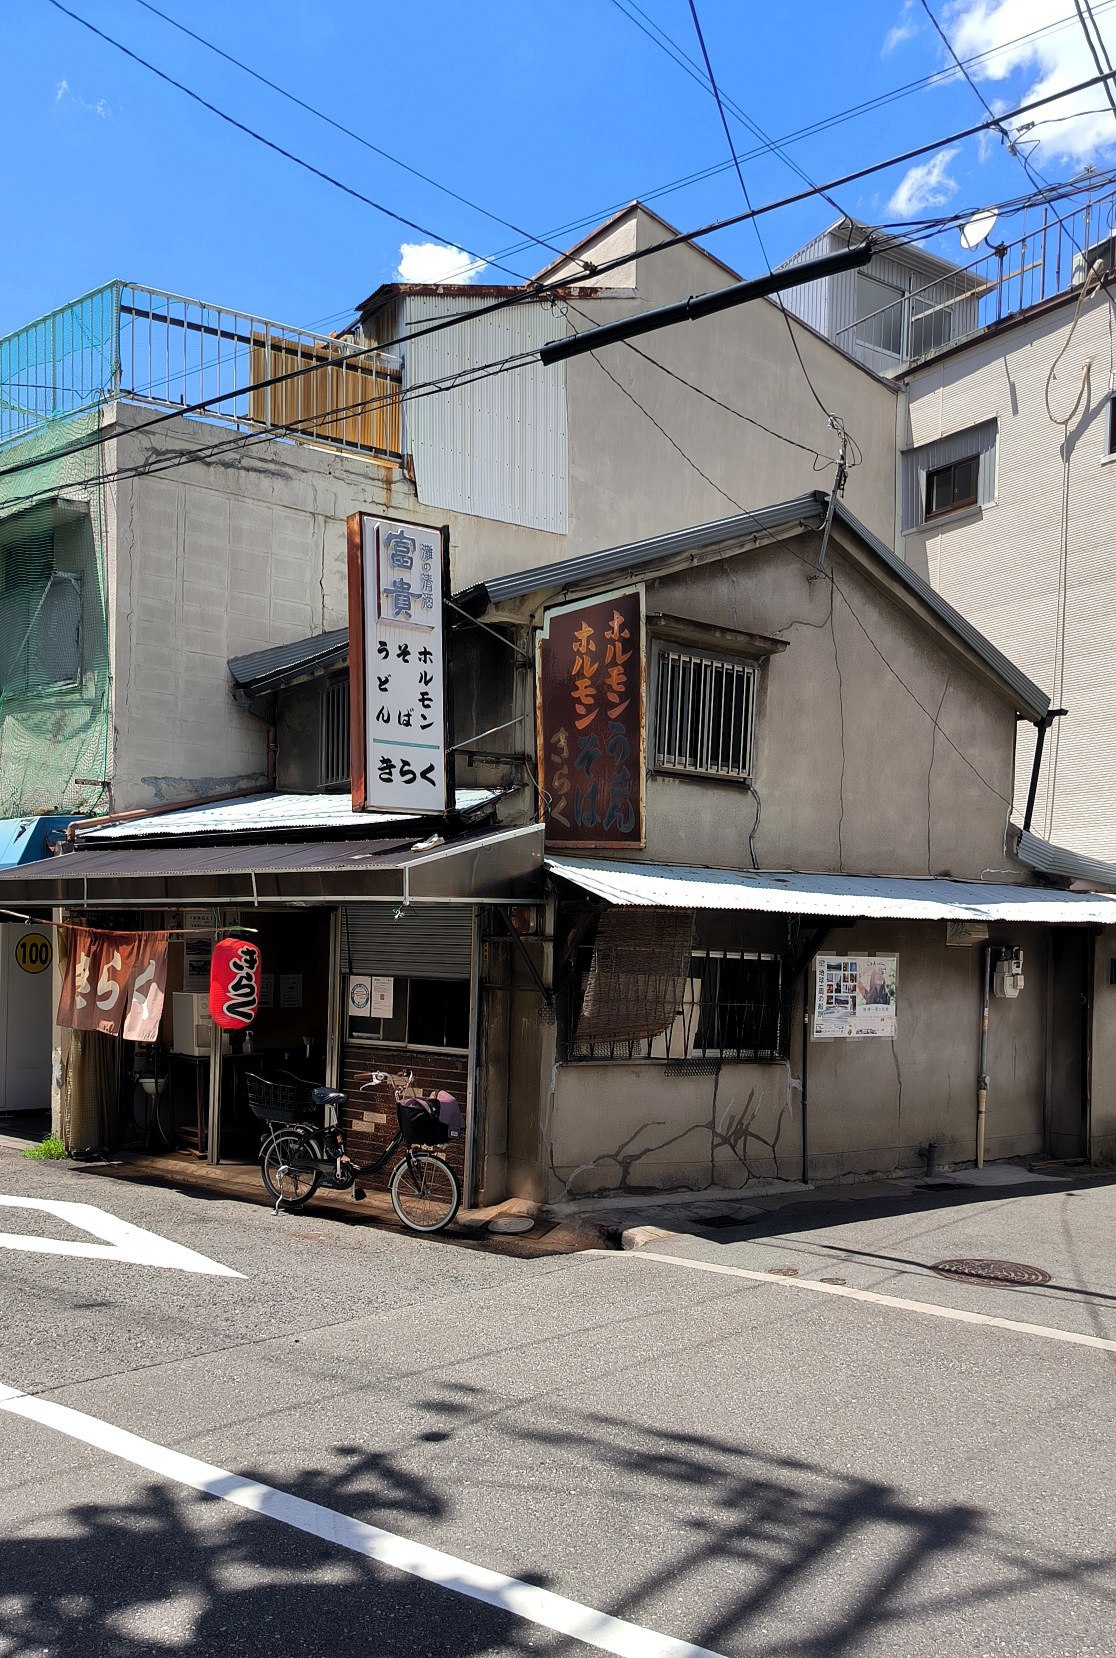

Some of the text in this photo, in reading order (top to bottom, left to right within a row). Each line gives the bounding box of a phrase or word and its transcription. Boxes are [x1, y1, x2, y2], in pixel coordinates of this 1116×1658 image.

[384, 529, 422, 619] 富貴
[421, 543, 434, 610] 灘の清酒
[376, 640, 392, 724] うどん
[396, 644, 414, 727] そば
[417, 646, 435, 731] ホルモン
[377, 755, 437, 787] きらく
[550, 727, 571, 828] きらく
[20, 942, 49, 965] 100
[75, 950, 156, 1021] きらく
[222, 946, 259, 1023] きらく
